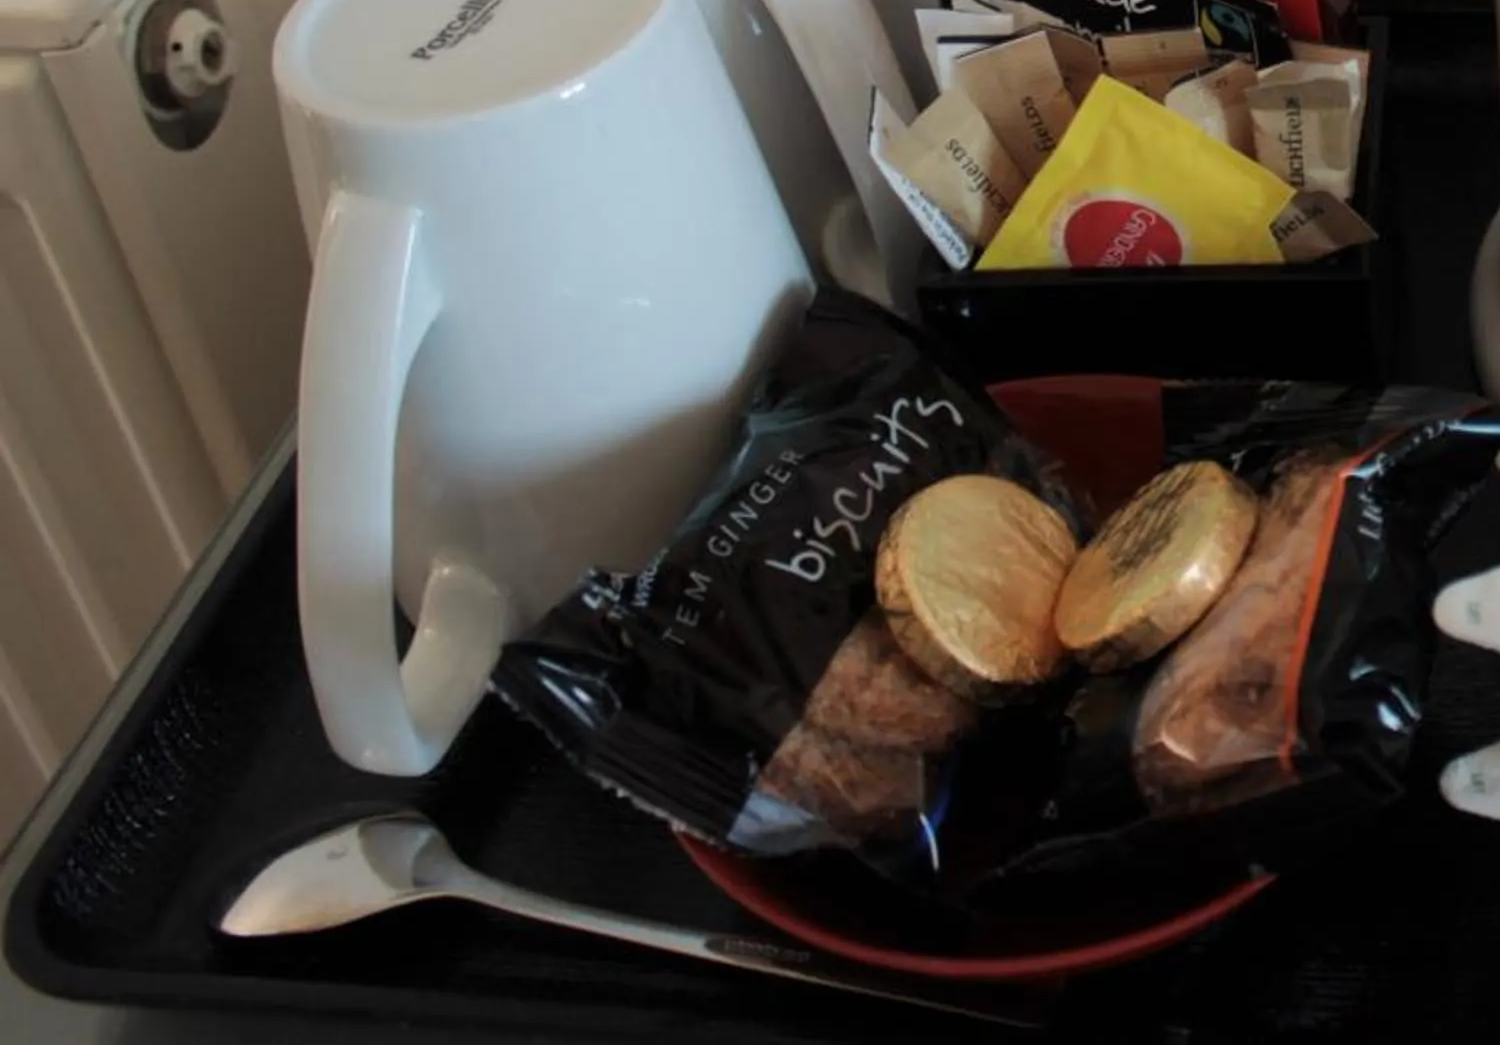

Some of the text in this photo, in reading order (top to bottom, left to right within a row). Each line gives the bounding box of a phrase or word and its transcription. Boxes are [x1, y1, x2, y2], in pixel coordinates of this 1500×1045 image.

[662, 450, 803, 646] TEM GINGER
[765, 395, 964, 583] biscuits
